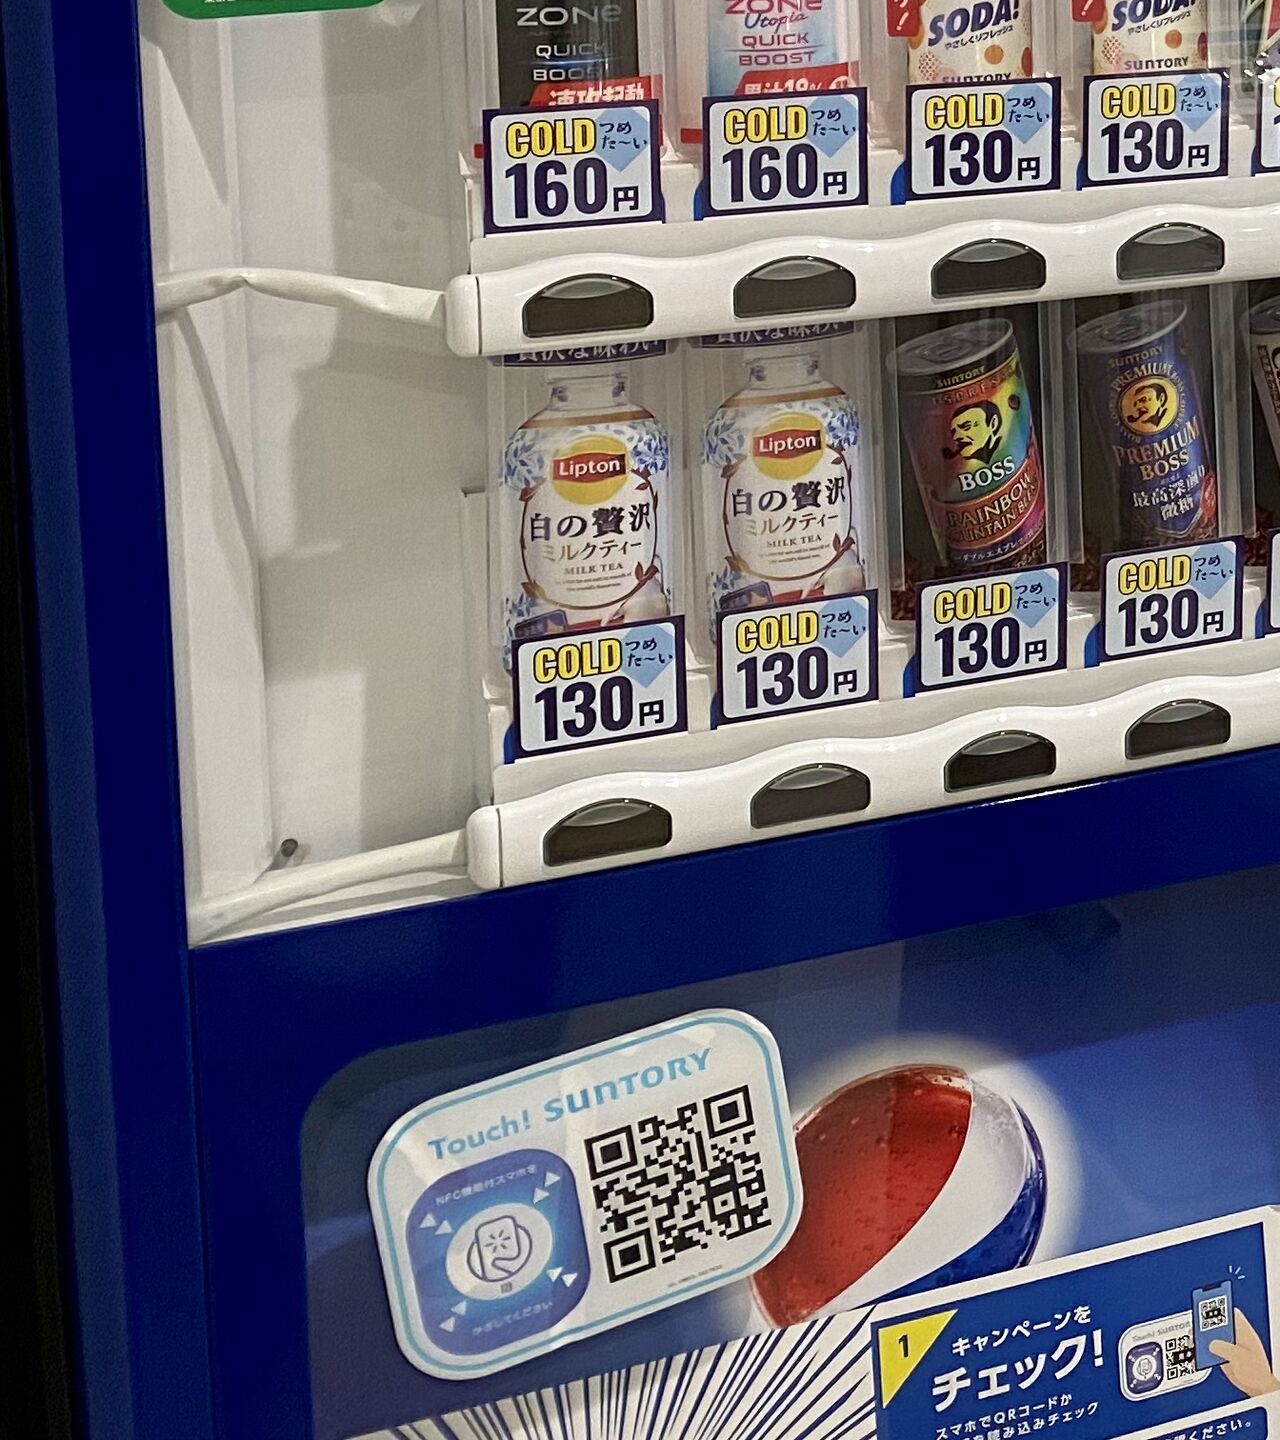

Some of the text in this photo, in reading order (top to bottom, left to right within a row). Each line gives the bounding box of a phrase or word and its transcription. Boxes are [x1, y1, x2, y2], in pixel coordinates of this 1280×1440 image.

[738, 49, 816, 66] BOOST
[741, 31, 809, 48] QUICK
[924, 92, 1004, 130] COLD
[1101, 119, 1210, 174] 130円
[722, 144, 848, 204] 160円
[559, 457, 621, 478] Lipton
[1139, 450, 1190, 480] BOSS
[529, 503, 651, 543] 白の贅沢
[541, 539, 643, 562] ミルクティー
[1118, 590, 1223, 648] 130円
[534, 638, 622, 684] COLD
[429, 1048, 710, 1160] Touch! SUNTORY
[952, 1305, 1092, 1356] キャンペーンを
[932, 1329, 1102, 1412] チェック!
